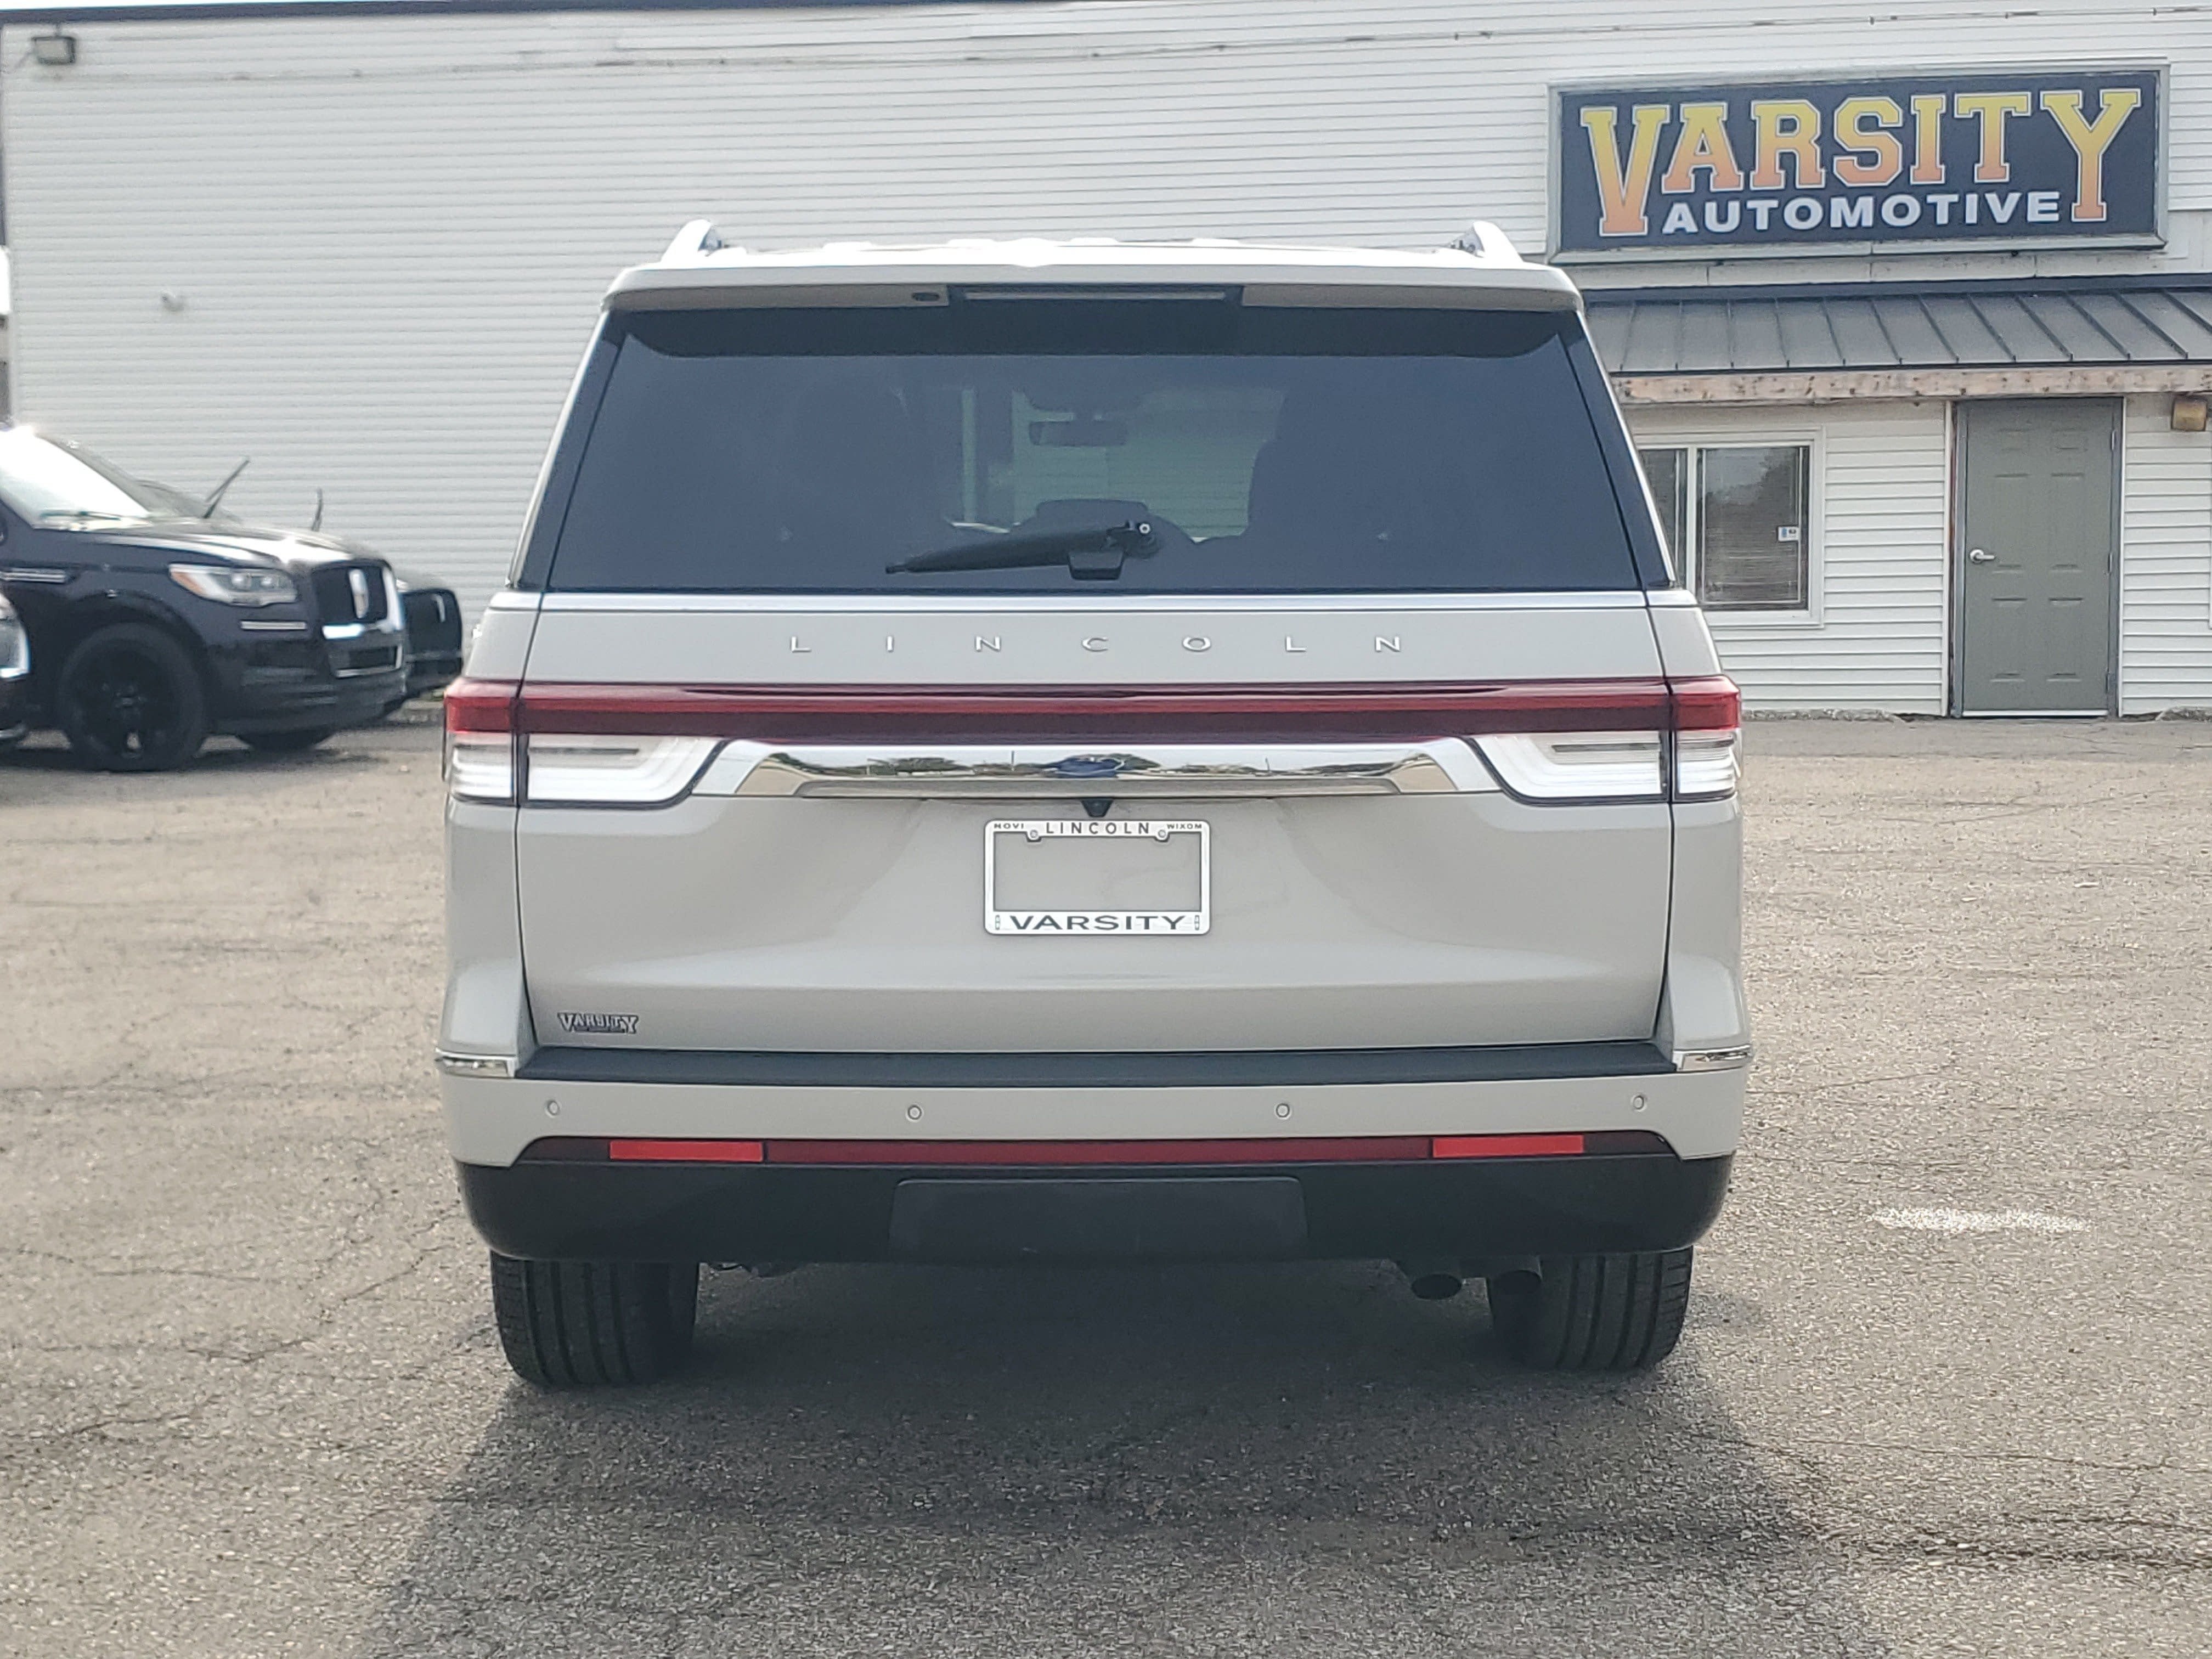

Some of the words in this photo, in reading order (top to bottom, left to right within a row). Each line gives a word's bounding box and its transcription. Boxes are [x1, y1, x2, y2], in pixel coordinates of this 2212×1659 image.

[1580, 87, 2141, 236] VARSITY
[1662, 191, 2061, 235] AUTOMOTIVE
[789, 636, 1402, 653] LINCOLN
[1046, 822, 1150, 834] LINCOLN
[1009, 915, 1186, 930] VARSITY
